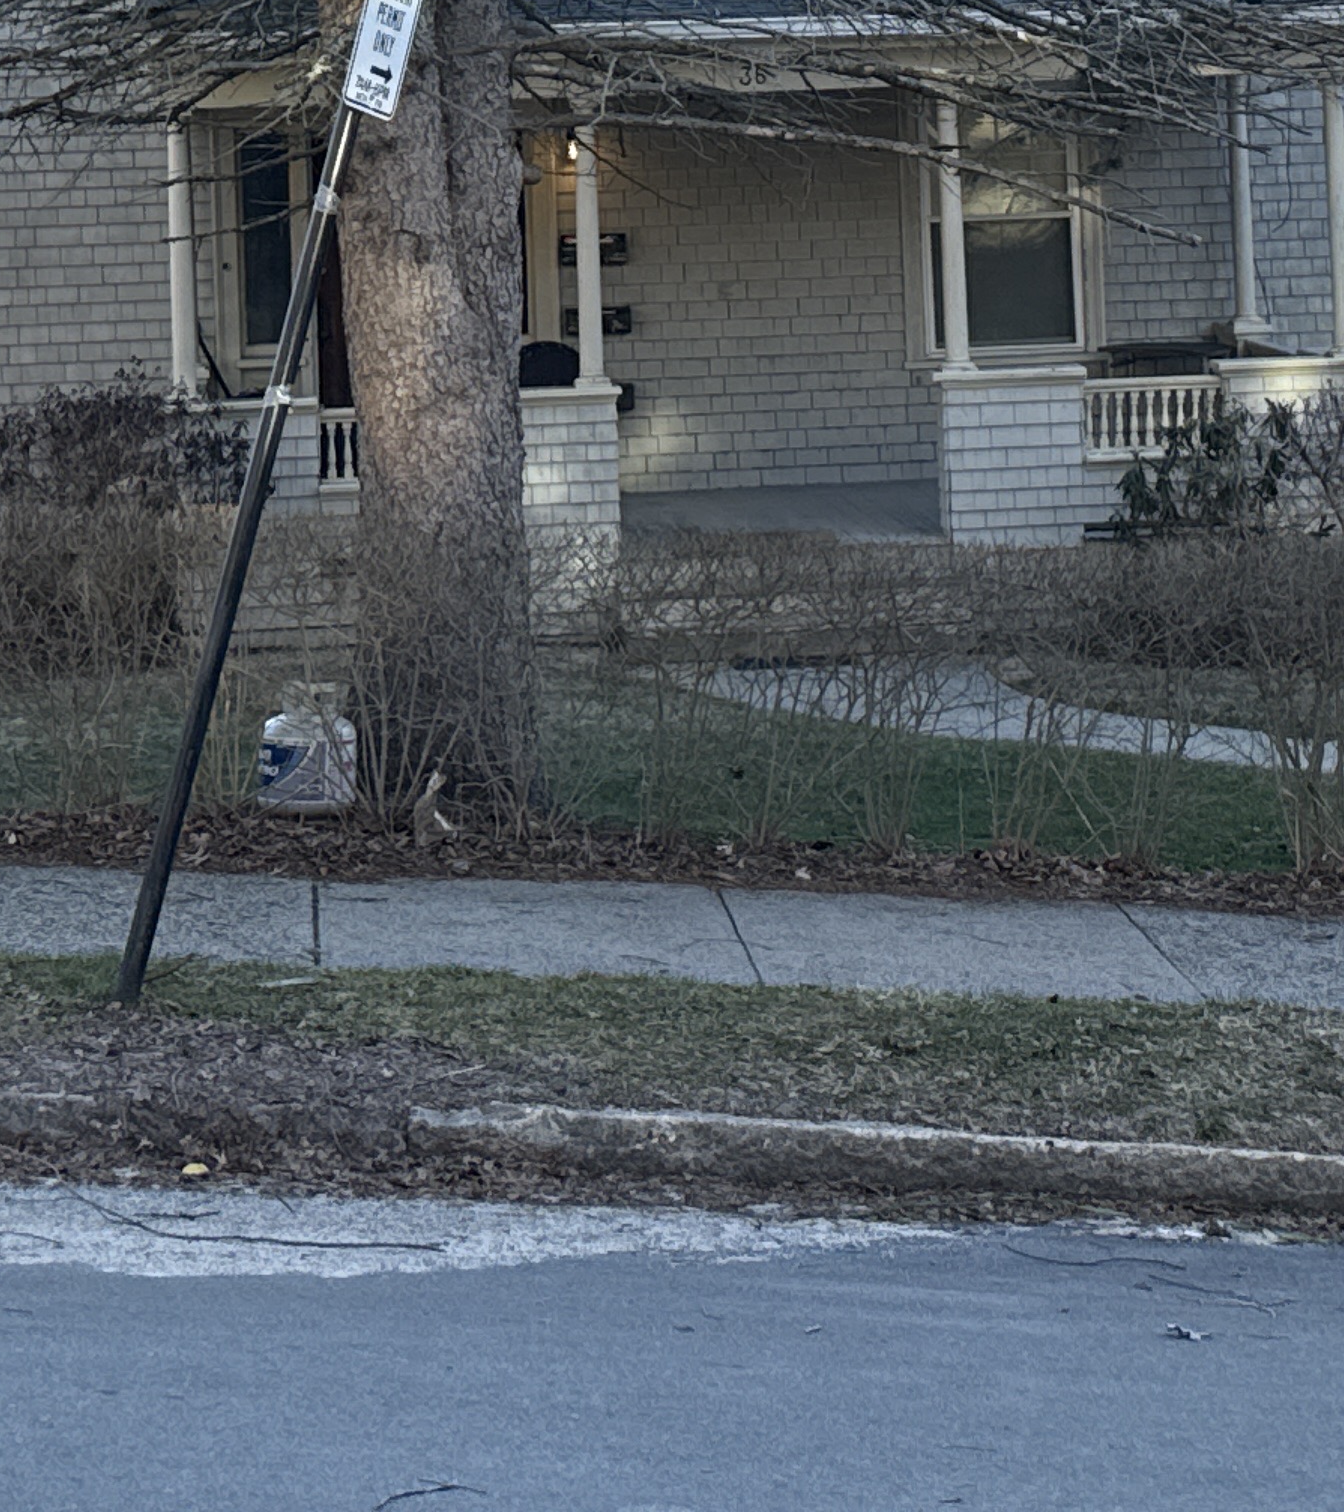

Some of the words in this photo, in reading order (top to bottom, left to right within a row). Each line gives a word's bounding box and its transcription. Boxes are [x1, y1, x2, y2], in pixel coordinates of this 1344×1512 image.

[376, 1, 406, 32] PERMIT
[372, 29, 396, 57] ONLY
[739, 59, 766, 86] 36
